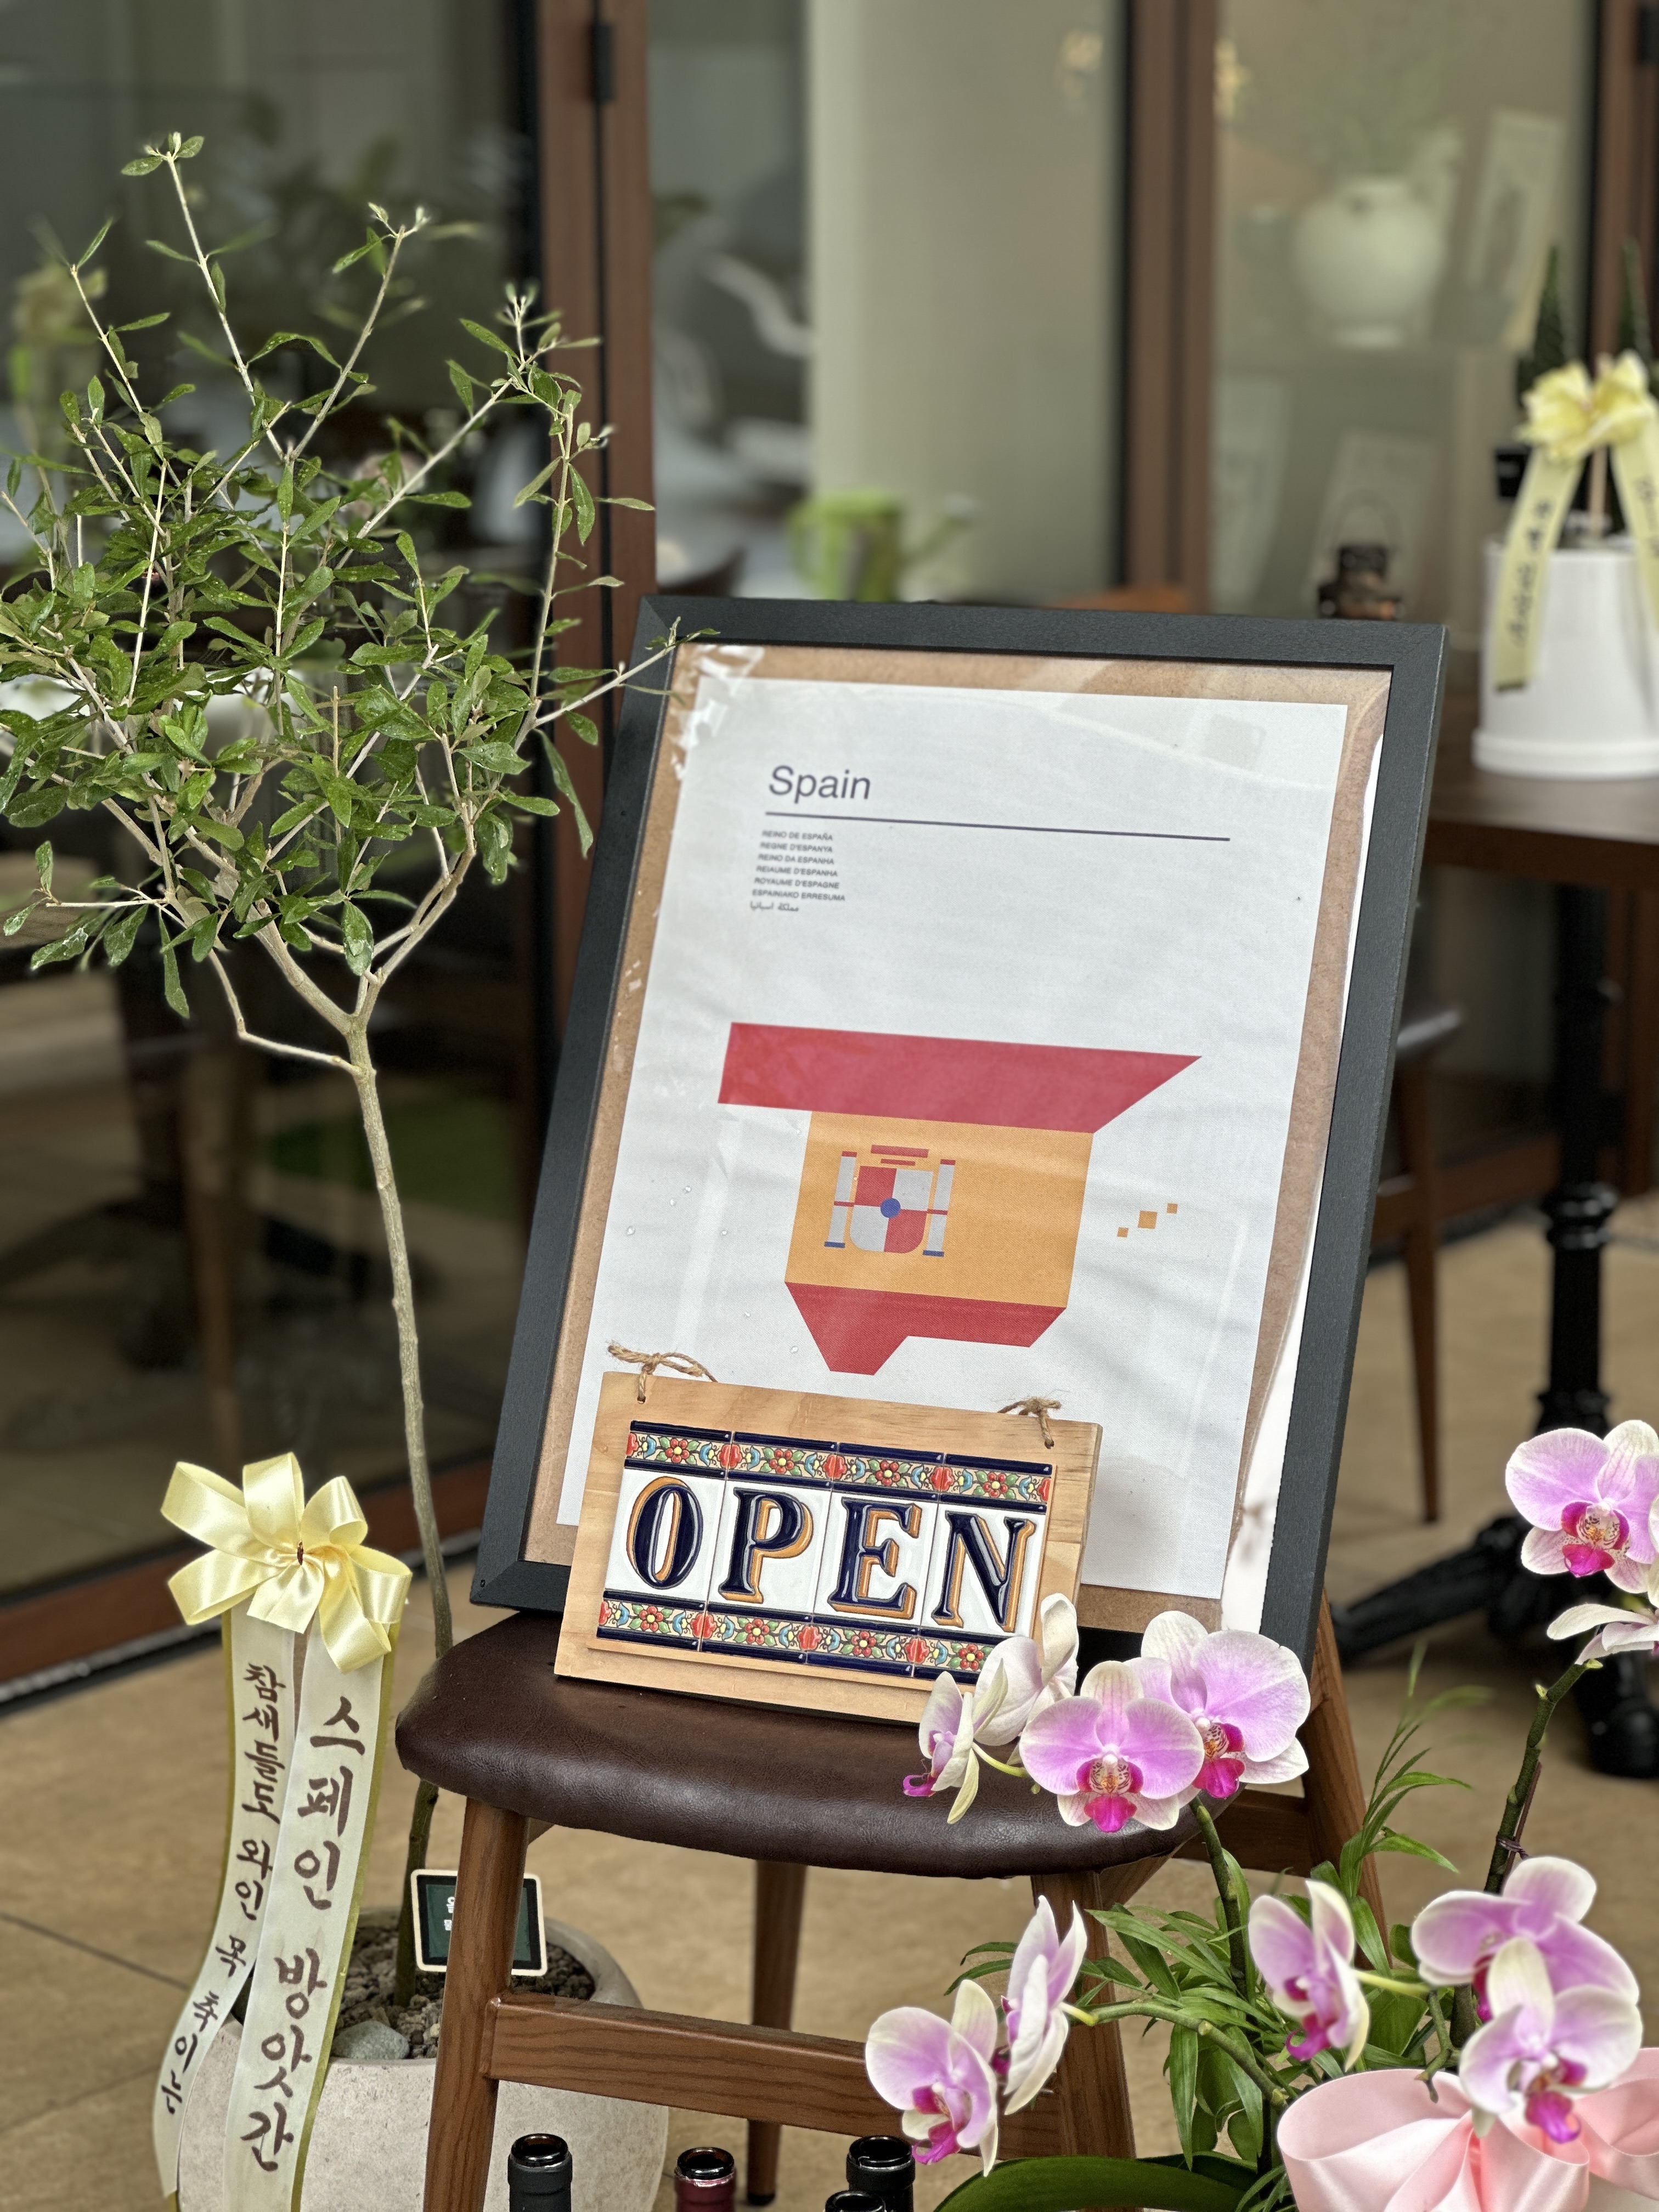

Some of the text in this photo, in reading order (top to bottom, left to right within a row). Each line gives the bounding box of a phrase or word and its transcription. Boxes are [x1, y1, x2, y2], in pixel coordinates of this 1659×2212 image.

[769, 765, 871, 804] Spain
[762, 830, 787, 838] REINO
[802, 832, 833, 841] ESPAÑA
[760, 842, 833, 853] REGNE D'ESPANYA
[798, 856, 834, 865] ESPANHA
[757, 865, 837, 877] REIAUME D'ESPANHA
[754, 877, 839, 889] ROYAUME D'ESPAGNE
[752, 889, 845, 901] ESPAINIAKO ERRESUMA
[626, 1476, 1036, 1633] OPEN
[161, 1662, 286, 2114] 참새들도 와인 목 축이는
[240, 1696, 365, 2172] 스페인 방앗간
